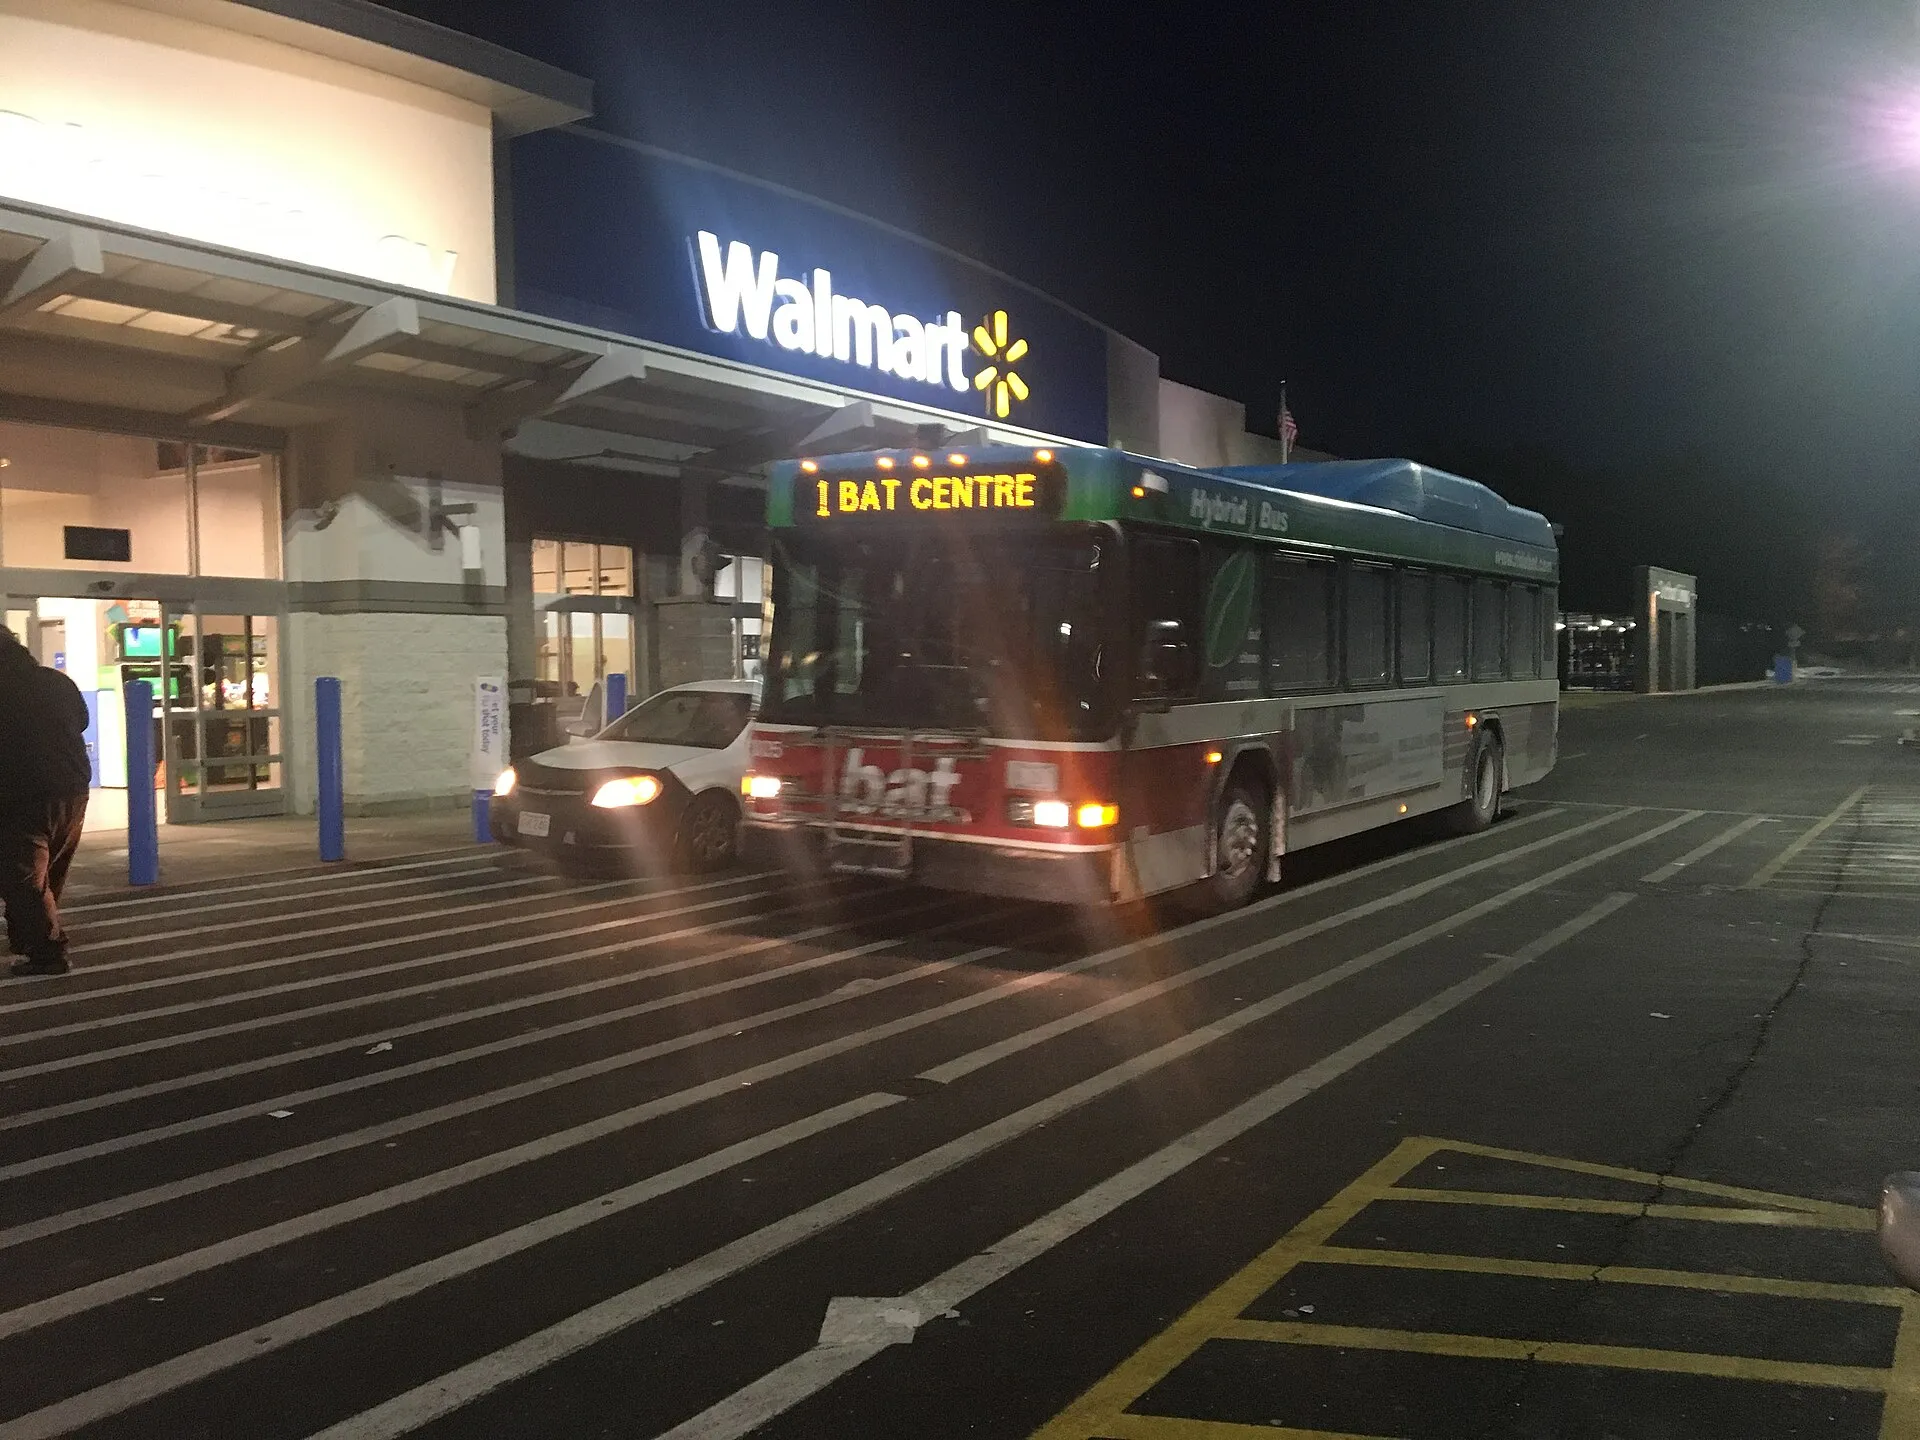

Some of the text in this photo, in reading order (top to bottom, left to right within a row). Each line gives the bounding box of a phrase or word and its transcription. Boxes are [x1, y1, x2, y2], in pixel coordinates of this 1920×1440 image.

[696, 230, 970, 391] Walmart
[816, 473, 1037, 517] 1 BAT CENTRE
[1190, 488, 1289, 532] Hybrid Bus
[842, 748, 962, 812] bat
